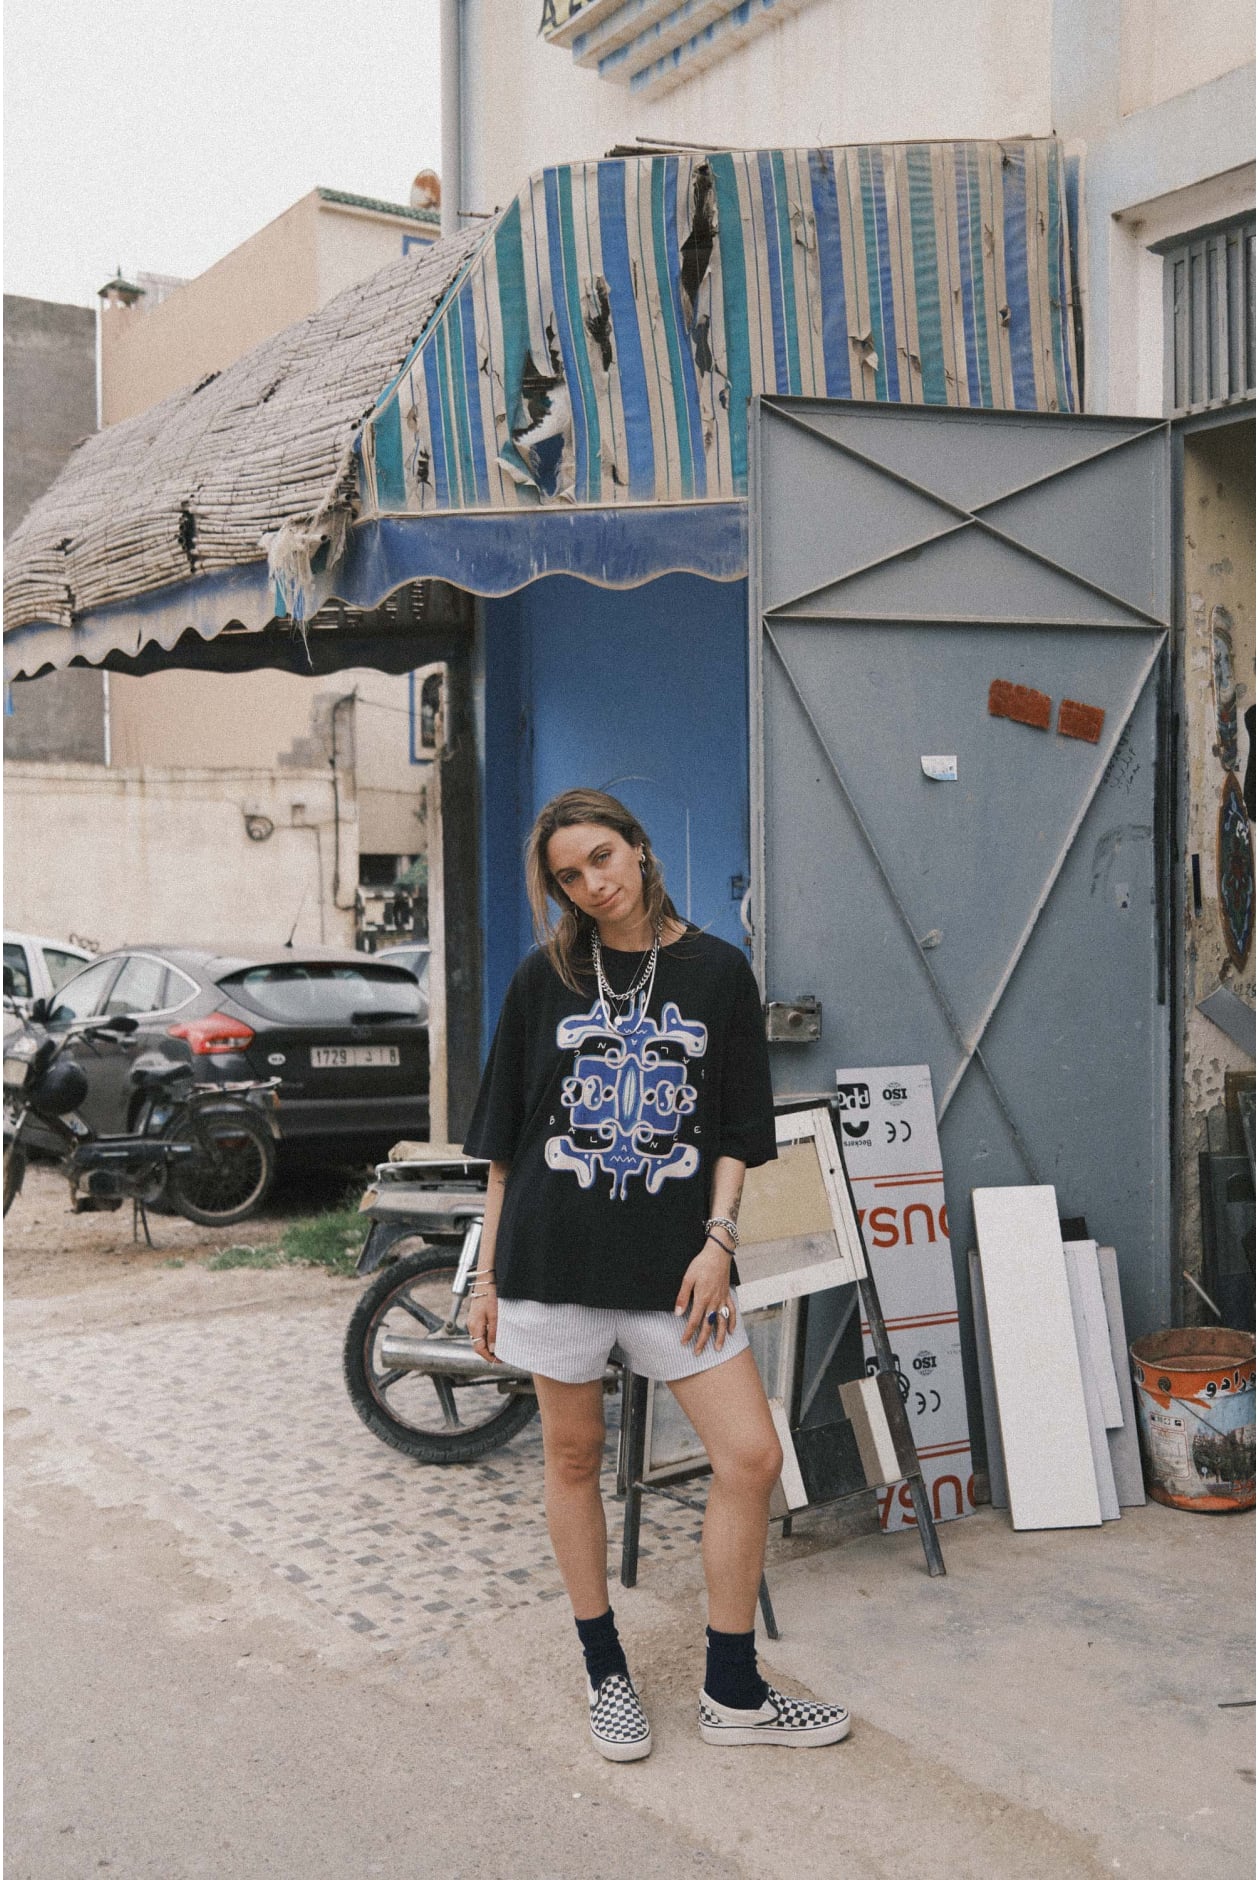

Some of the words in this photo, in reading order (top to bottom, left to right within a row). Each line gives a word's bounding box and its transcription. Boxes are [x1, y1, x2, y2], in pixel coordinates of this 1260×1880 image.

[316, 1048, 347, 1065] 1729
[882, 1088, 908, 1101] ISO
[843, 1139, 872, 1148] Beckers
[913, 1356, 937, 1371] ISO
